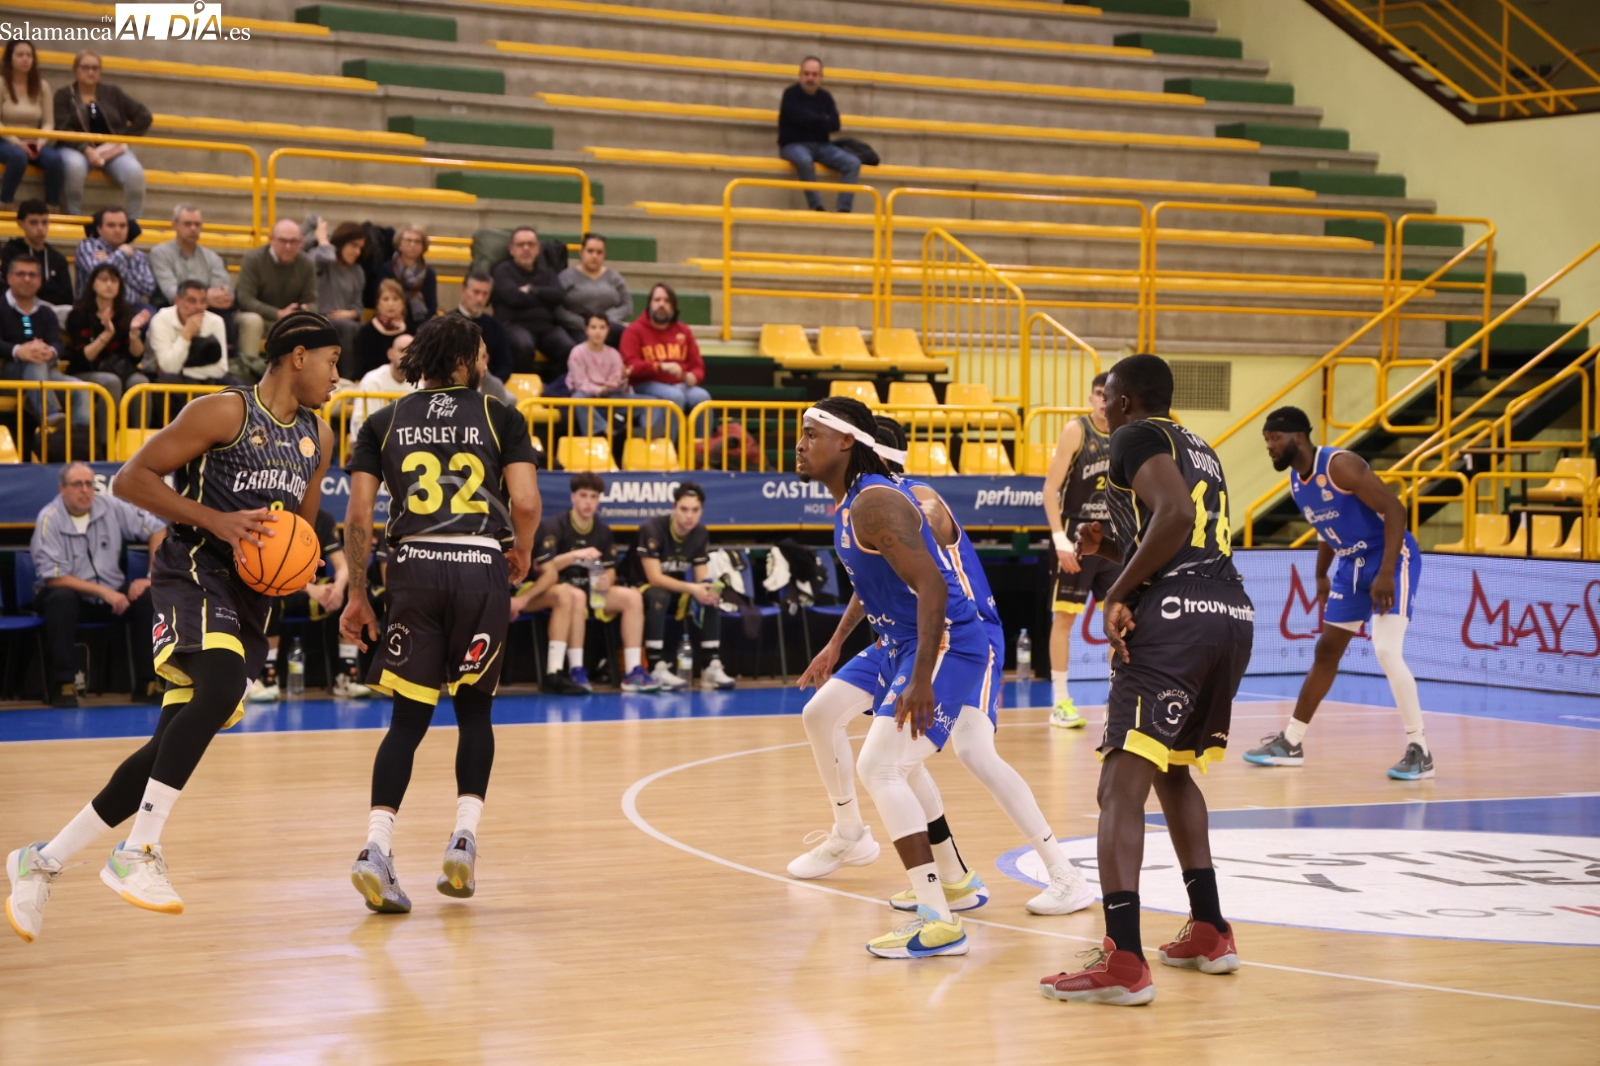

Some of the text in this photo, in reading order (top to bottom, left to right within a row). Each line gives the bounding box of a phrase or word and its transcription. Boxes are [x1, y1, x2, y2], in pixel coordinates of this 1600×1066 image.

[396, 426, 484, 446] TEASLEY JR.
[1081, 459, 1110, 481] CARBA
[400, 450, 490, 516] 32
[599, 481, 681, 503] LAMANC
[761, 480, 834, 500] CASTILL
[974, 485, 1044, 510] perfume
[1461, 568, 1600, 658] MAYS
[1228, 872, 1364, 894] Y
